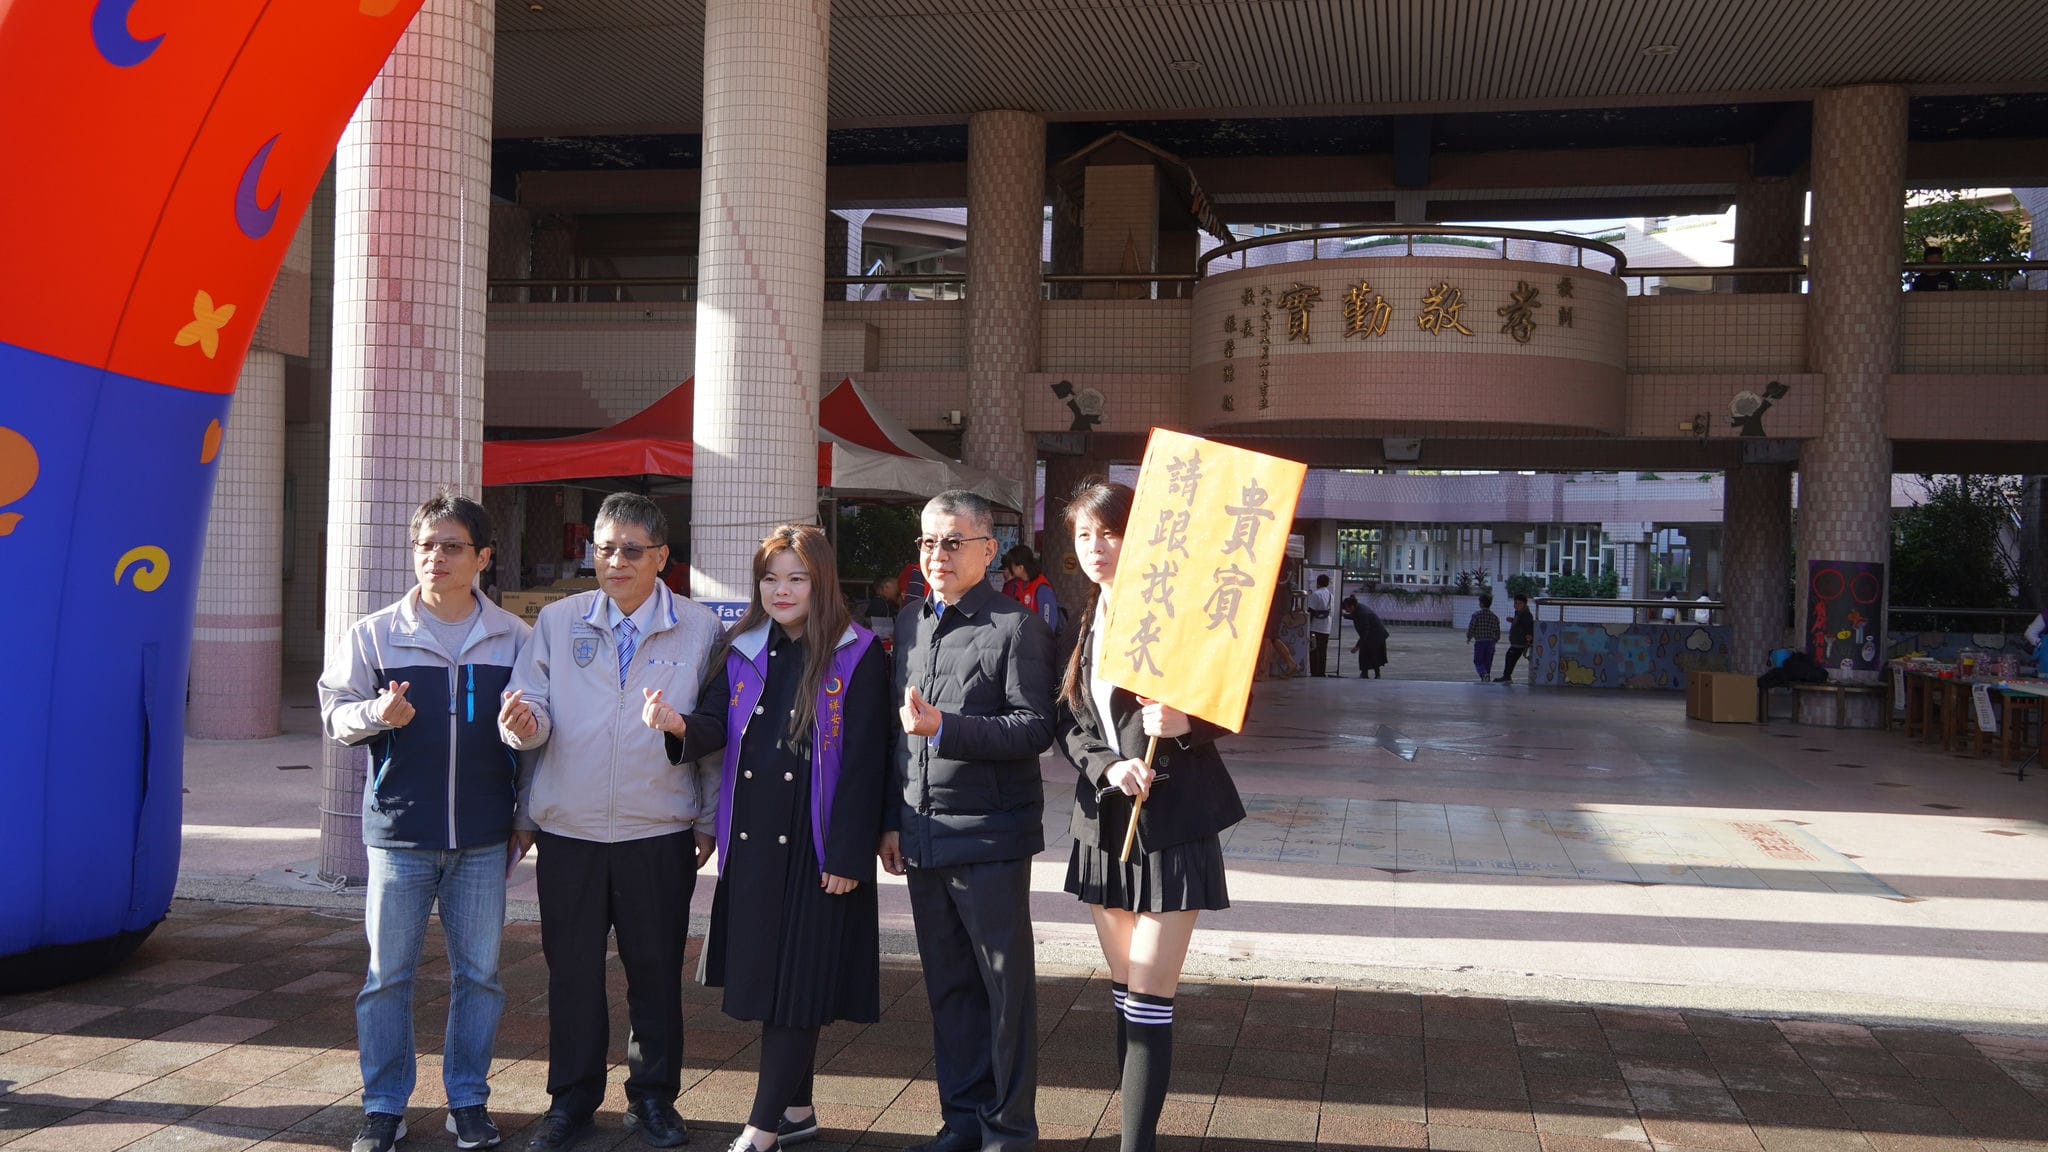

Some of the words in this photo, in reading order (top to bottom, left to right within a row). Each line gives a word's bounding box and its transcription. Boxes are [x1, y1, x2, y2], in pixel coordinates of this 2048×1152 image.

[1124, 448, 1203, 679] 請跟我來
[1203, 478, 1276, 640] 貴賓
